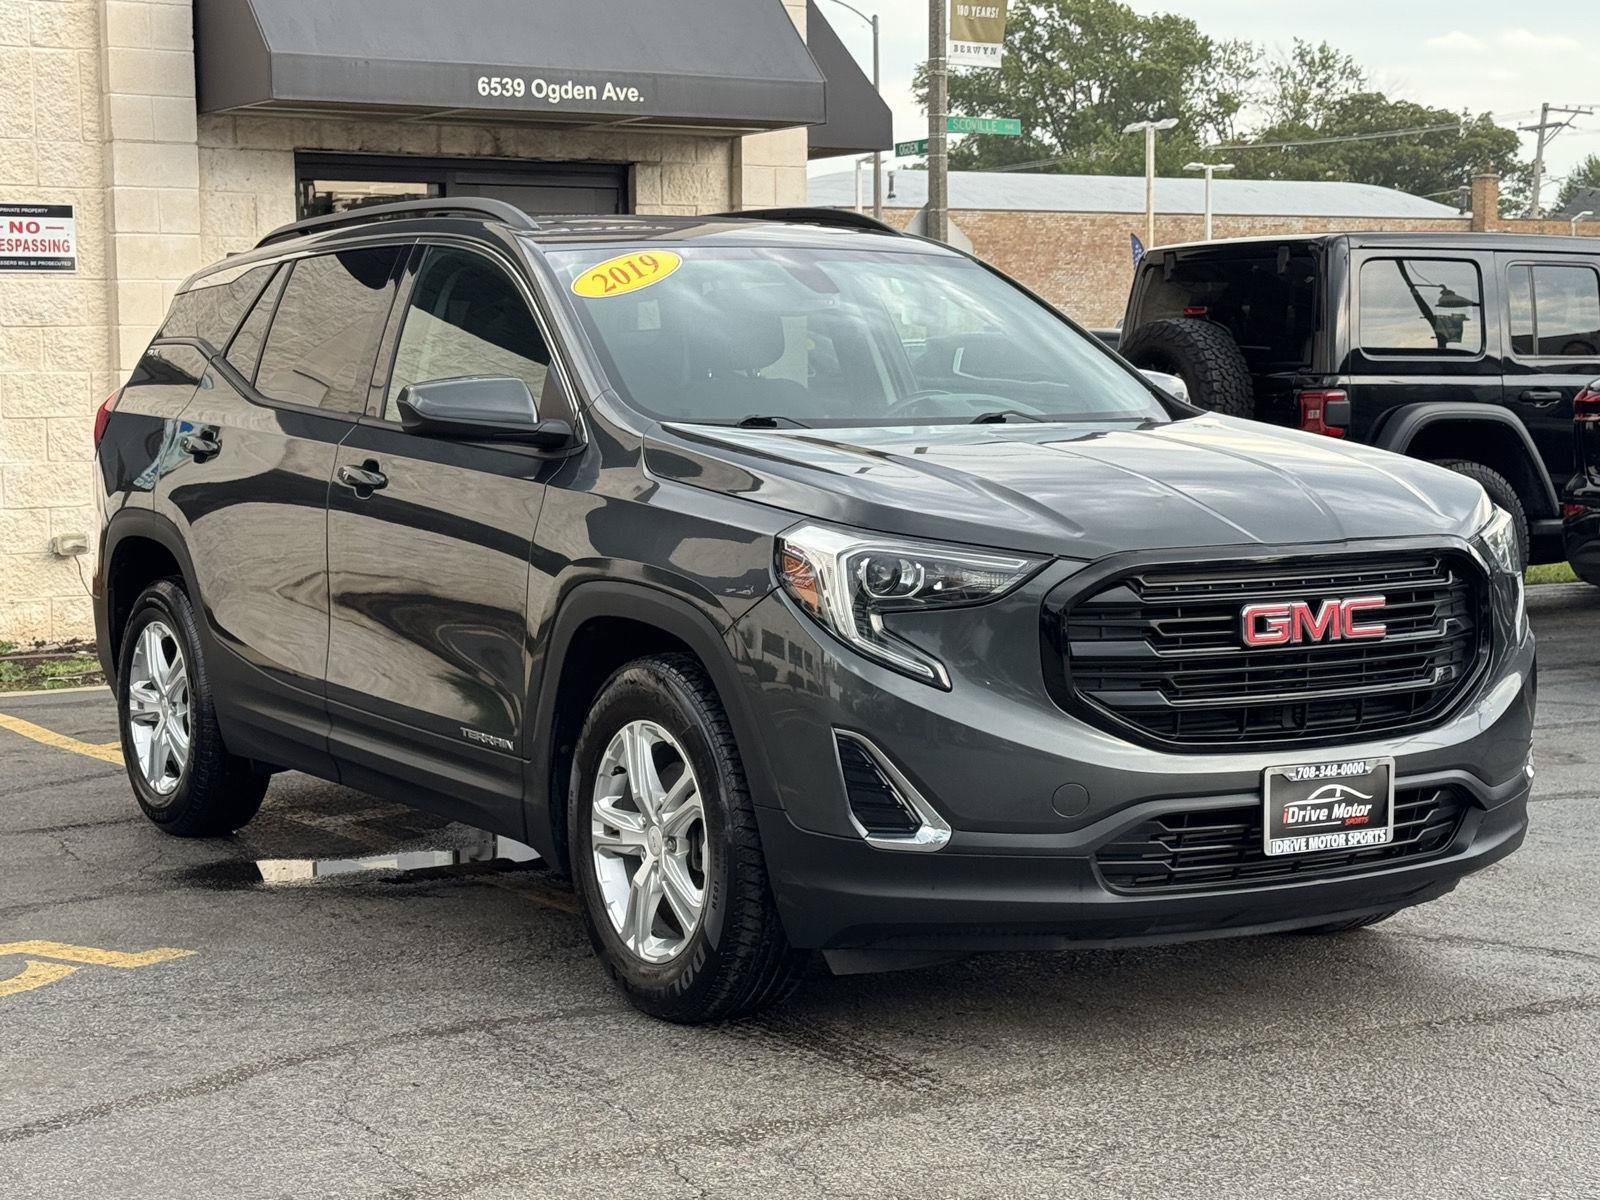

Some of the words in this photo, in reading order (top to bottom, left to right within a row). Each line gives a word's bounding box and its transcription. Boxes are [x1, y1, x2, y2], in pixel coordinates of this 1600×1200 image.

[971, 5, 999, 18] YEARS!
[953, 44, 997, 56] BERWYN
[477, 76, 525, 98] 6539
[531, 78, 597, 103] Ogden
[601, 81, 645, 102] Ave.
[952, 118, 998, 132] SCOVILLE
[9, 221, 40, 234] NO
[592, 254, 659, 293] 2019
[1241, 594, 1386, 648] GMC
[460, 726, 514, 751] TERRAIN
[1297, 761, 1365, 779] 708-348-0000
[1282, 805, 1328, 825] iDrive
[1331, 802, 1372, 820] Motor
[1308, 834, 1346, 851] MOTOR
[1347, 829, 1386, 847] SPORTS
